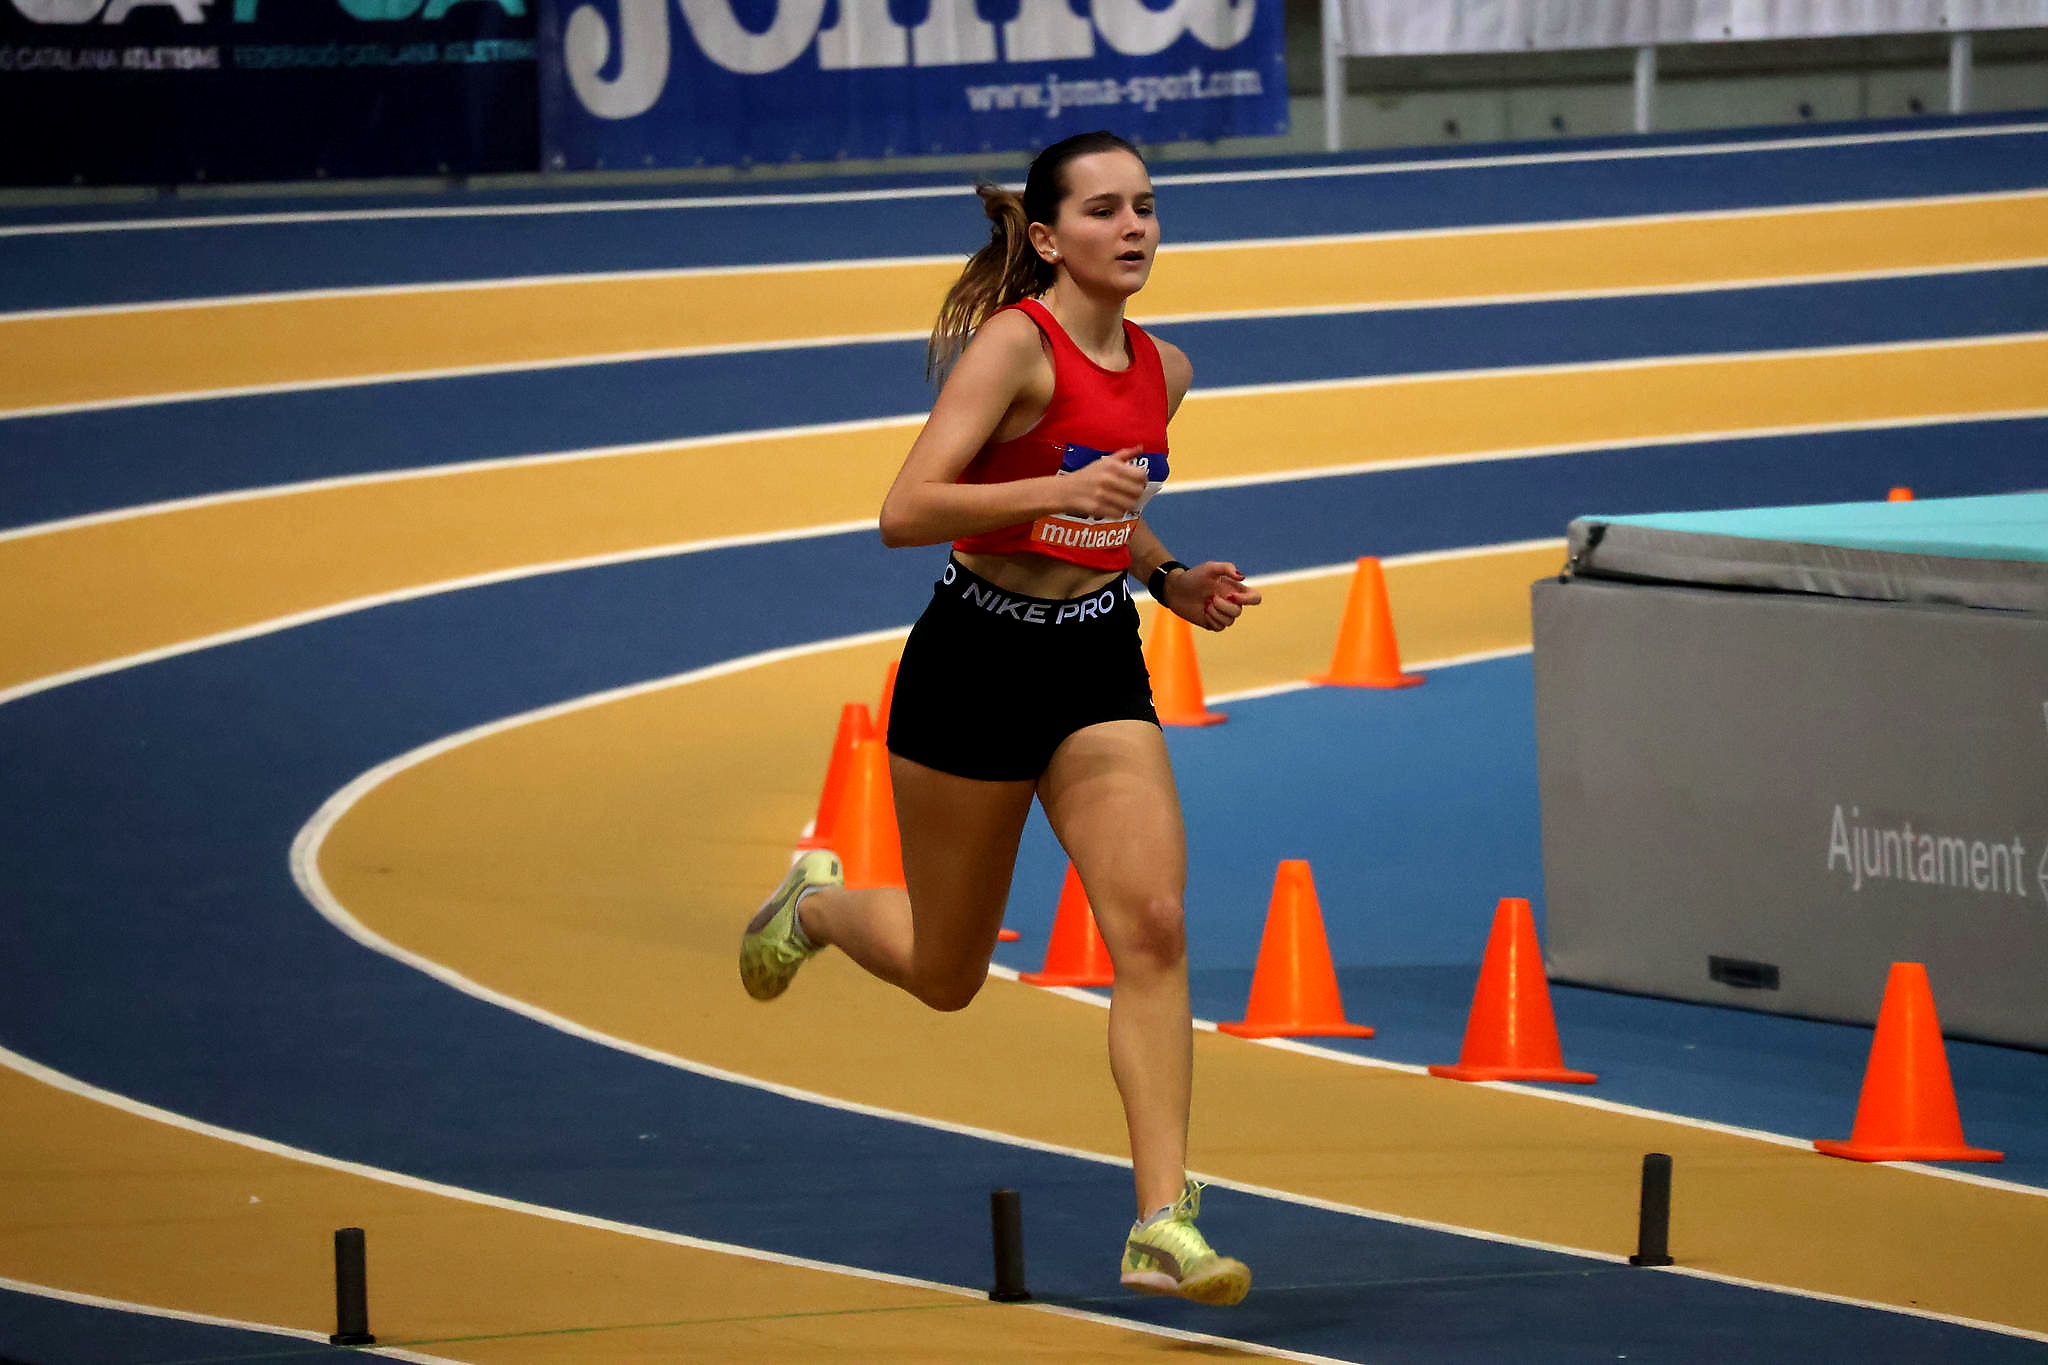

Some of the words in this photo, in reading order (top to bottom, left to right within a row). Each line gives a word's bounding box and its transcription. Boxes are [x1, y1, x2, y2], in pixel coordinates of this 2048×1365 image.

[965, 67, 1263, 119] www.joma-sport.com
[1040, 523, 1131, 548] mutuacat
[962, 582, 1052, 625] NIKE
[1055, 590, 1115, 625] PRO
[1827, 804, 2027, 896] Ajuntament
